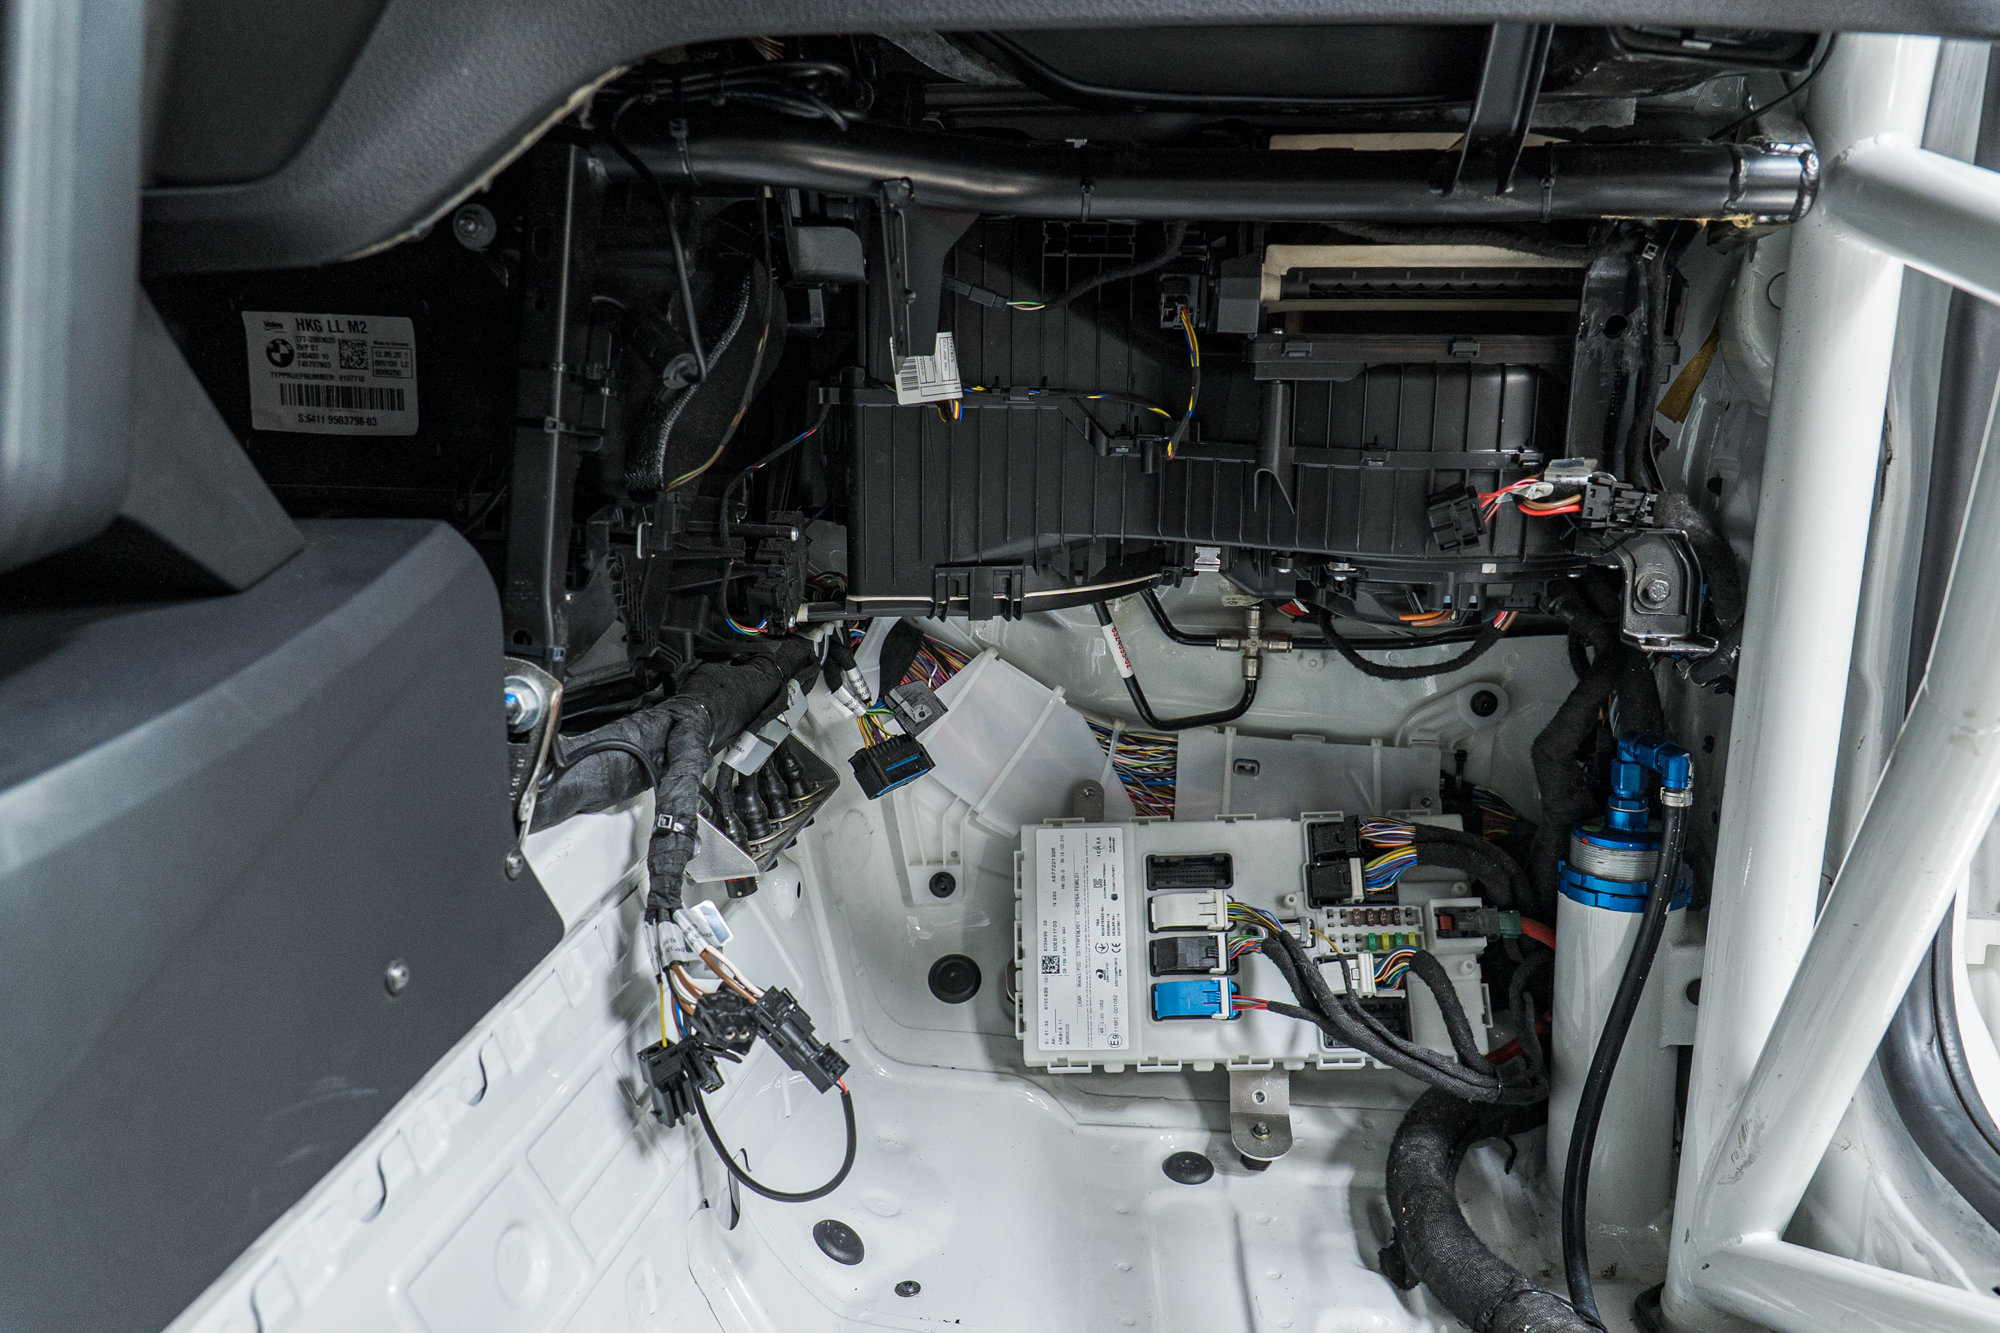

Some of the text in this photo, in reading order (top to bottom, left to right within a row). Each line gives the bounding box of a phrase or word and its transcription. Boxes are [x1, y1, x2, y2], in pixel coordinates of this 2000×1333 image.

[296, 318, 368, 334] HKG LL M2
